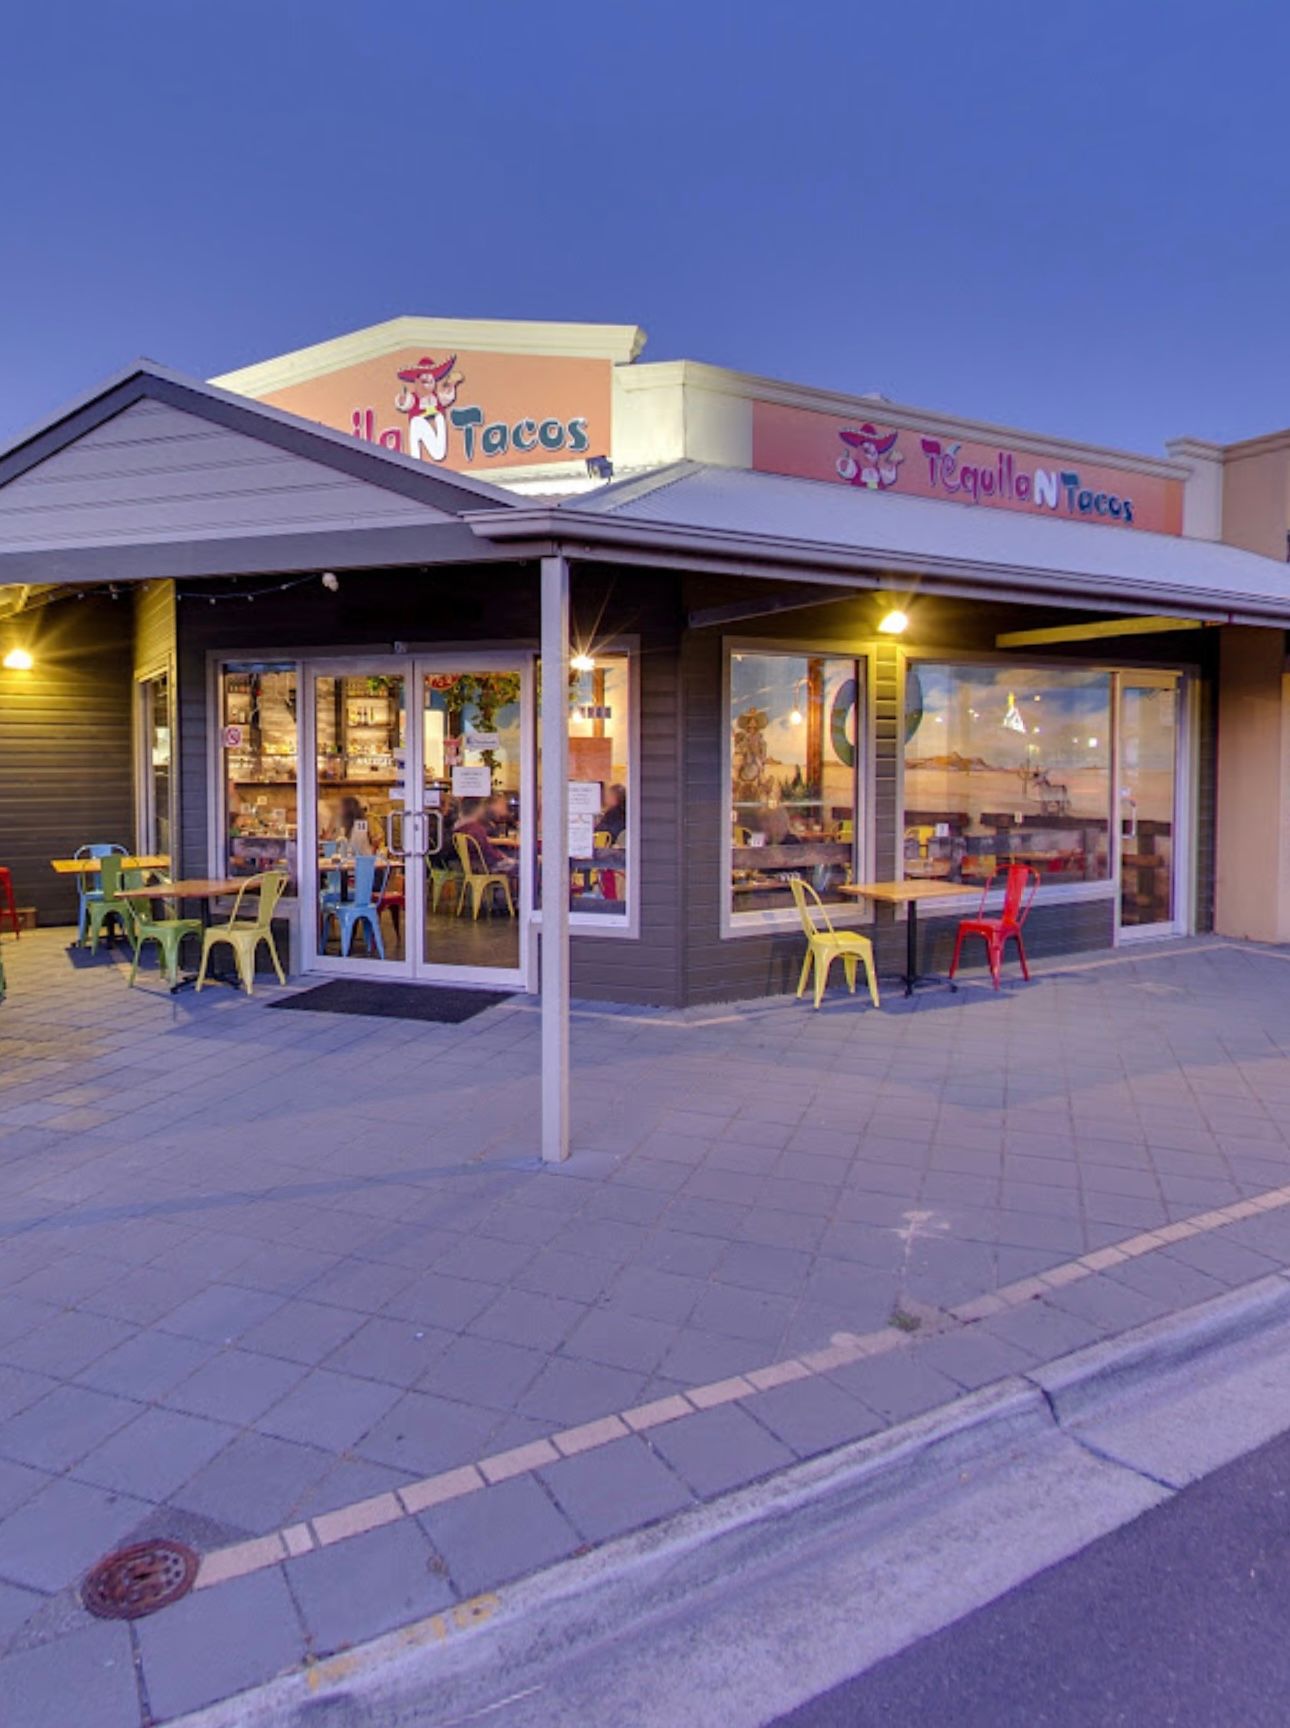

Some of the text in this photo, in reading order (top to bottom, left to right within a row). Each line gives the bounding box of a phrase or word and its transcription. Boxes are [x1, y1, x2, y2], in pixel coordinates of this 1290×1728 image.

[410, 415, 447, 461] N
[451, 406, 589, 460] Tacos
[1034, 468, 1058, 508] N
[1061, 471, 1133, 523] Tacos
